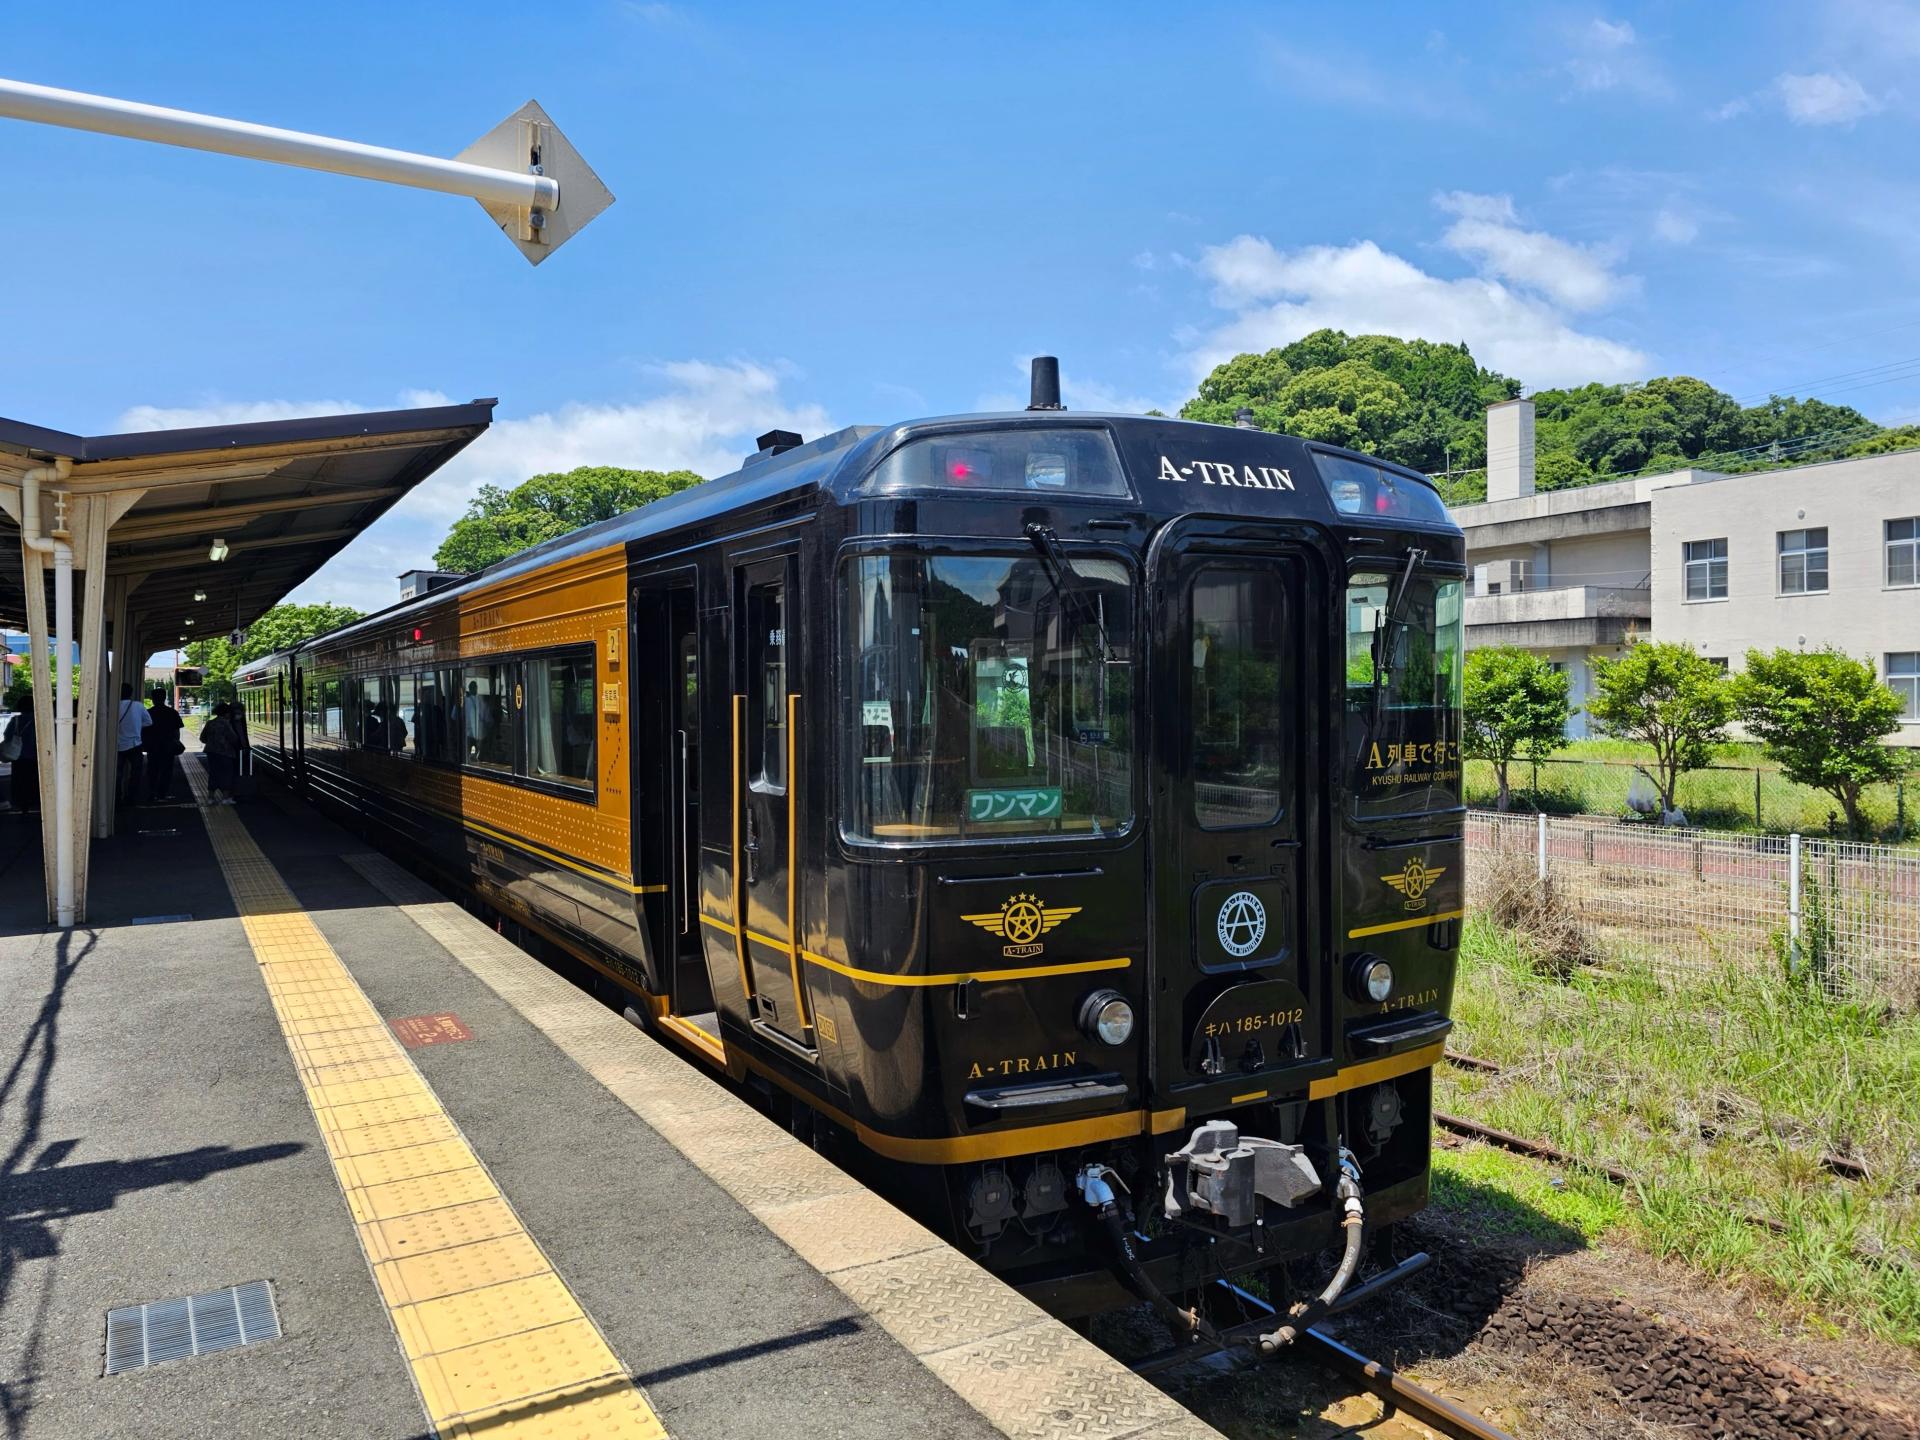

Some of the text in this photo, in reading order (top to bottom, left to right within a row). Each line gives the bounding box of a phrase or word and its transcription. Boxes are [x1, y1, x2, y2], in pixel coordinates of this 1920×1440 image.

[1371, 774, 1402, 786] KYUSHU
[1403, 772, 1431, 783] RAILWAY
[972, 792, 1058, 818] ワンマン
[1006, 945, 1041, 955] A-TRAIN
[1205, 1008, 1302, 1037] キハ 185-1012
